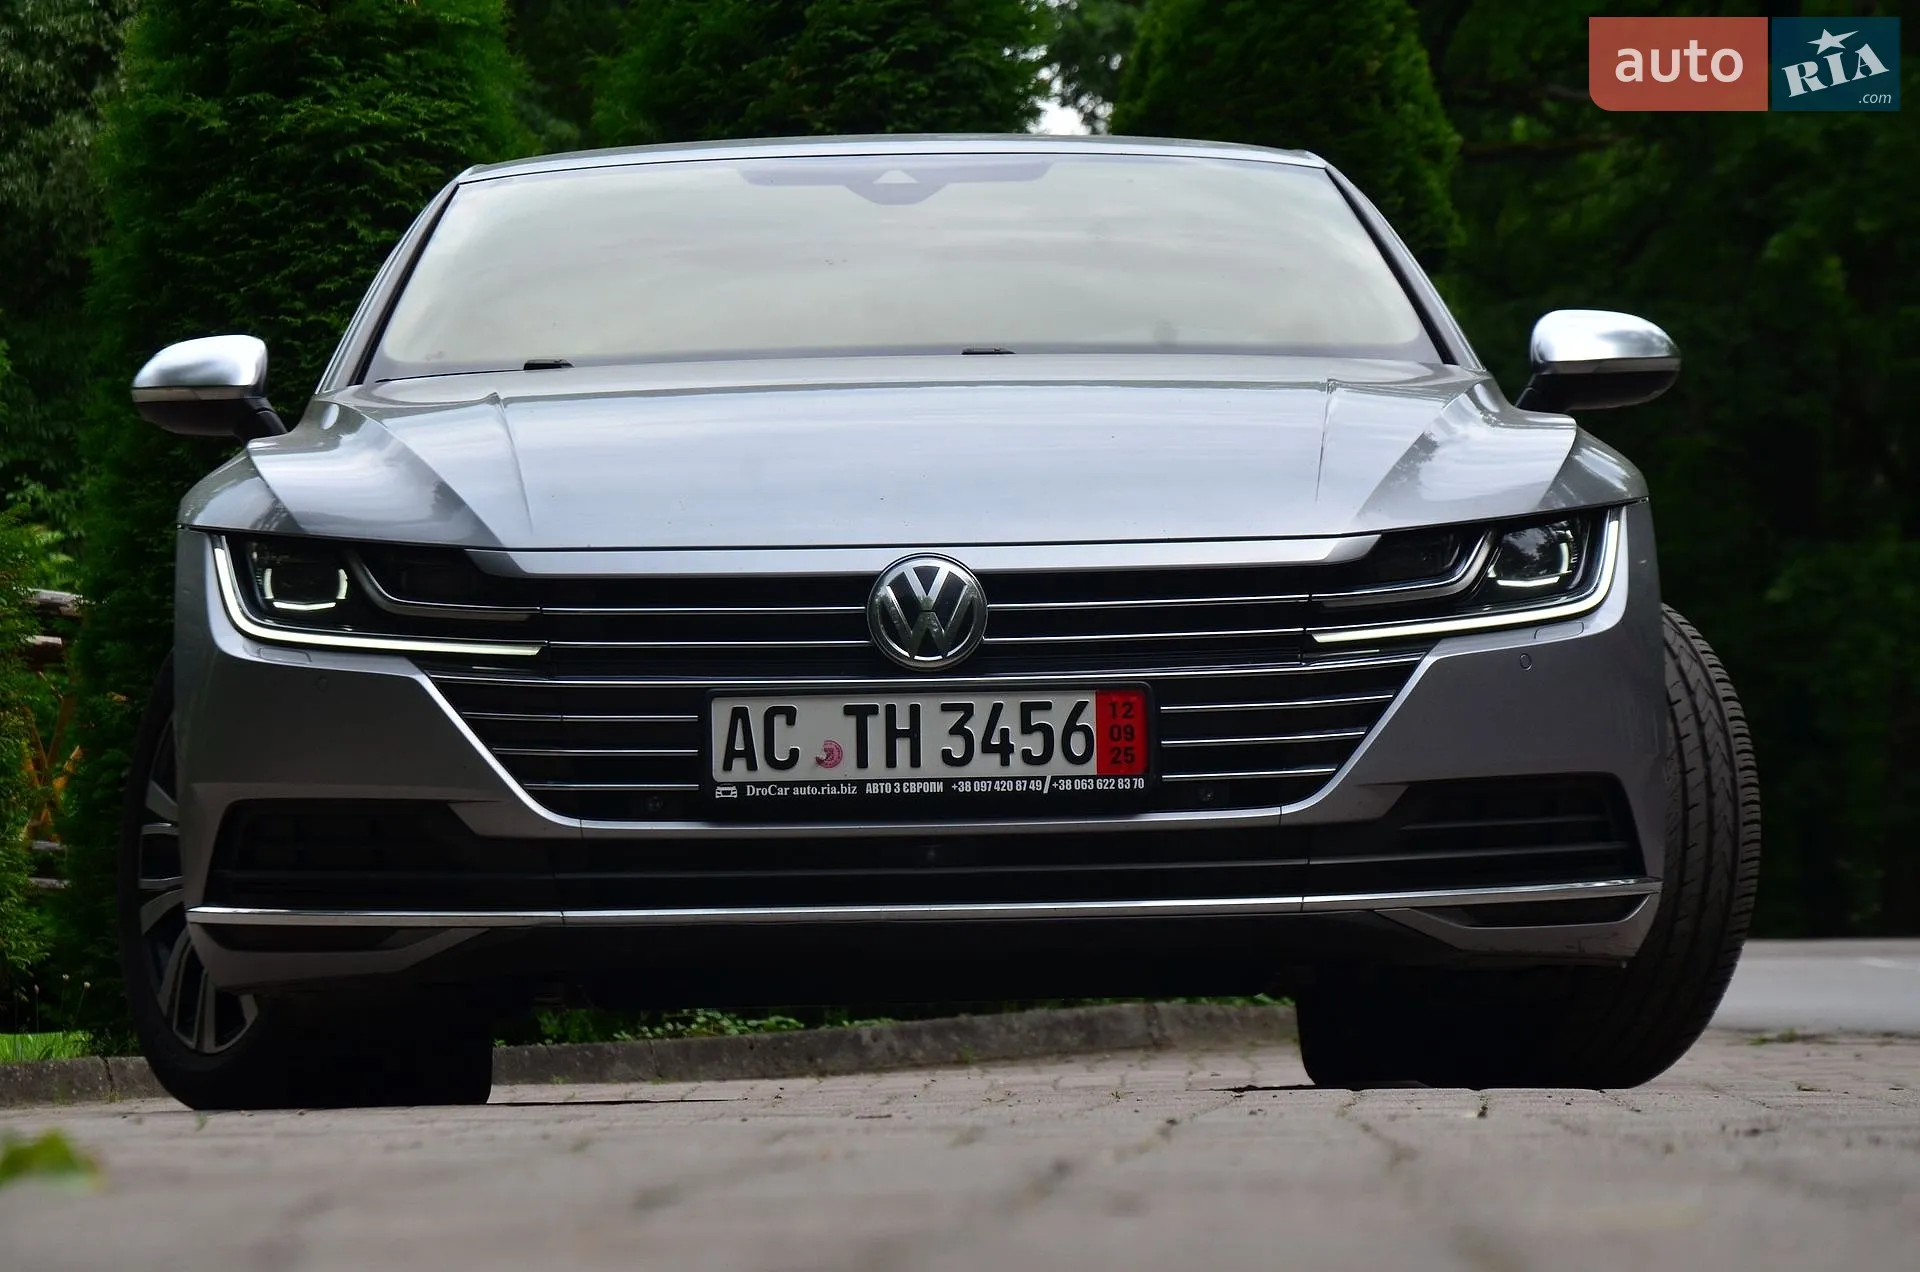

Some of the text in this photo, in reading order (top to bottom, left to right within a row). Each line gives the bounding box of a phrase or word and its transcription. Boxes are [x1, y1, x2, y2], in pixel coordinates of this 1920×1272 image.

[1108, 701, 1135, 719] 12
[723, 704, 800, 771] AC
[843, 702, 921, 769] TH
[940, 699, 1095, 767] 3456
[1109, 724, 1135, 742] 09
[1109, 747, 1135, 765] 25
[746, 784, 790, 797] DroCar
[792, 783, 858, 796] auto.ria.biz
[865, 782, 892, 794] АВТО
[902, 781, 944, 794] ЄВРОПИ
[951, 780, 972, 793] +38
[973, 780, 992, 793] 097
[994, 780, 1013, 792] 420
[1015, 780, 1027, 792] 87
[1029, 779, 1042, 791] 49
[1052, 779, 1072, 791] +38
[1074, 779, 1094, 791] 063
[1096, 778, 1115, 790] 622
[1117, 778, 1131, 790] 83
[1132, 777, 1145, 789] 70
